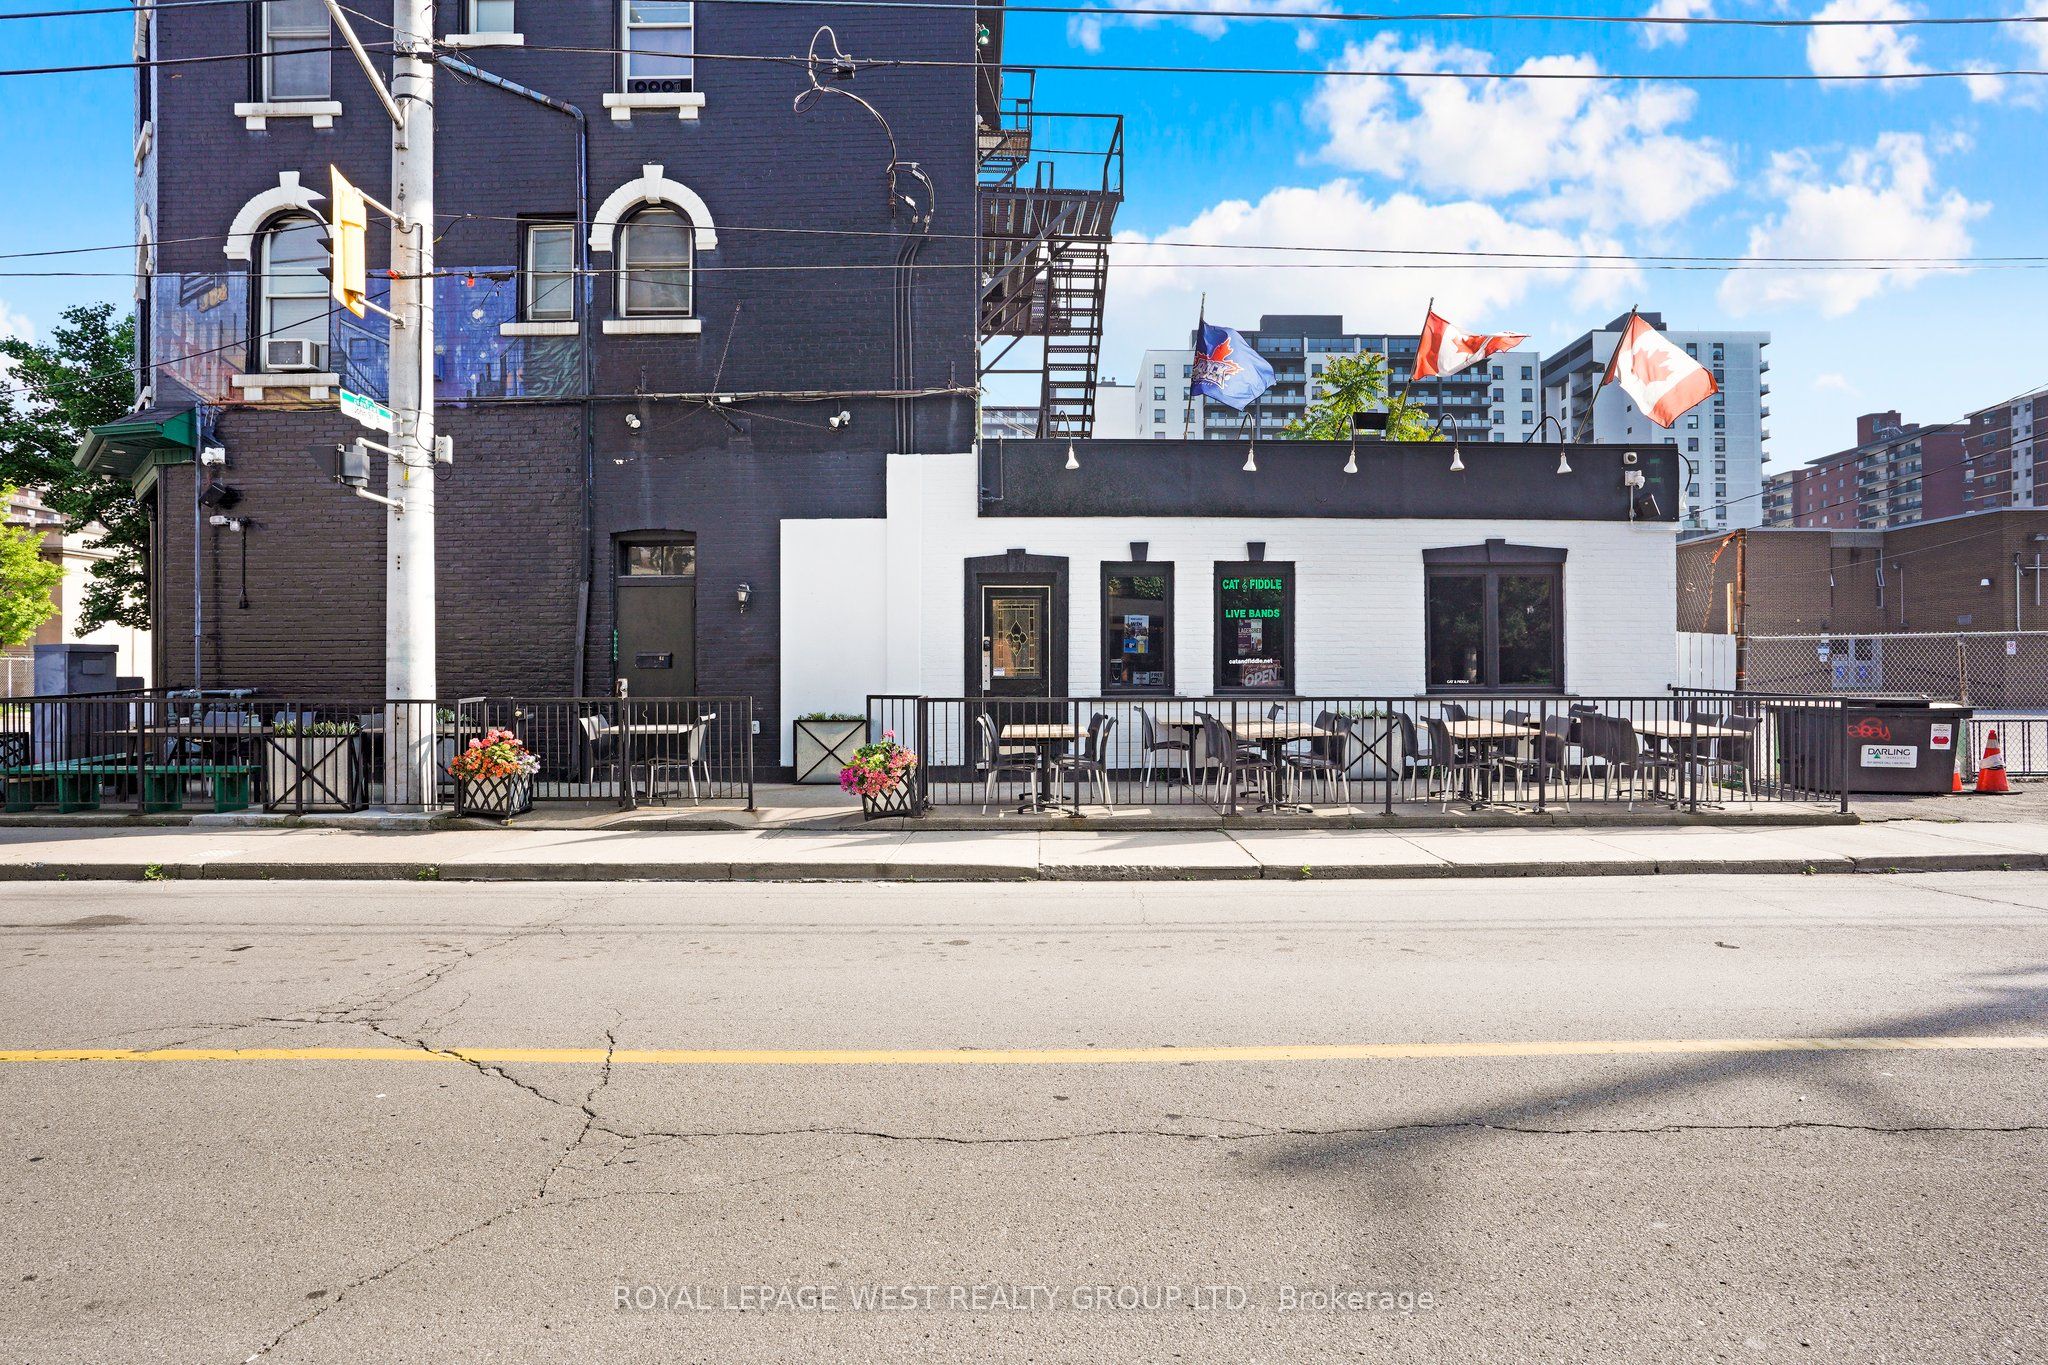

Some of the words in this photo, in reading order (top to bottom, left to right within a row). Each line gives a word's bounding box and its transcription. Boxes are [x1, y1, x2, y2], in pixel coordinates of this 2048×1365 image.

[1222, 579, 1239, 589] CAT
[1250, 579, 1282, 589] FIDDLE
[1225, 609, 1246, 618] LIVE
[1249, 609, 1280, 618] BANDS
[1244, 667, 1278, 687] OPEN
